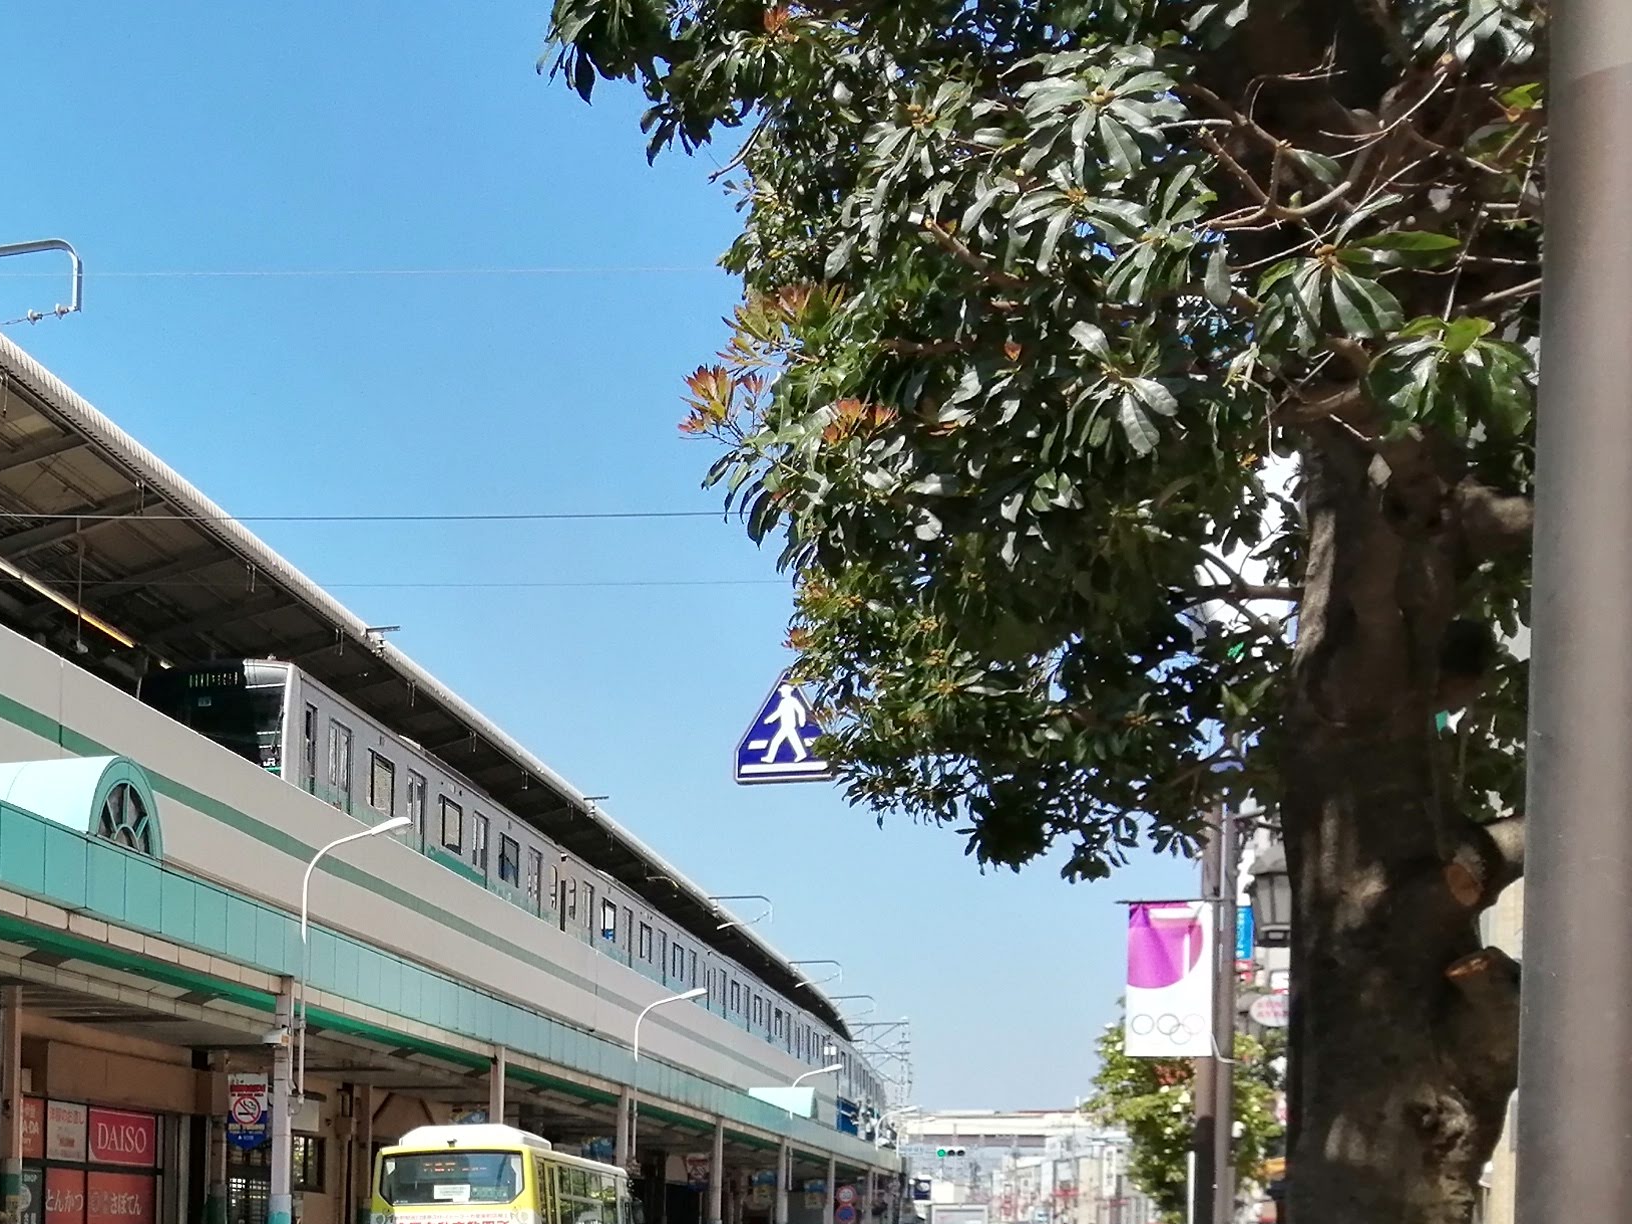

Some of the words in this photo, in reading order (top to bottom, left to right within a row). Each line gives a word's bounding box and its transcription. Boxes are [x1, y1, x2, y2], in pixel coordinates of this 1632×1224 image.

[97, 1122, 147, 1154] DAISO
[45, 1189, 84, 1213] とんかつ
[110, 1193, 142, 1216] さぼてん
